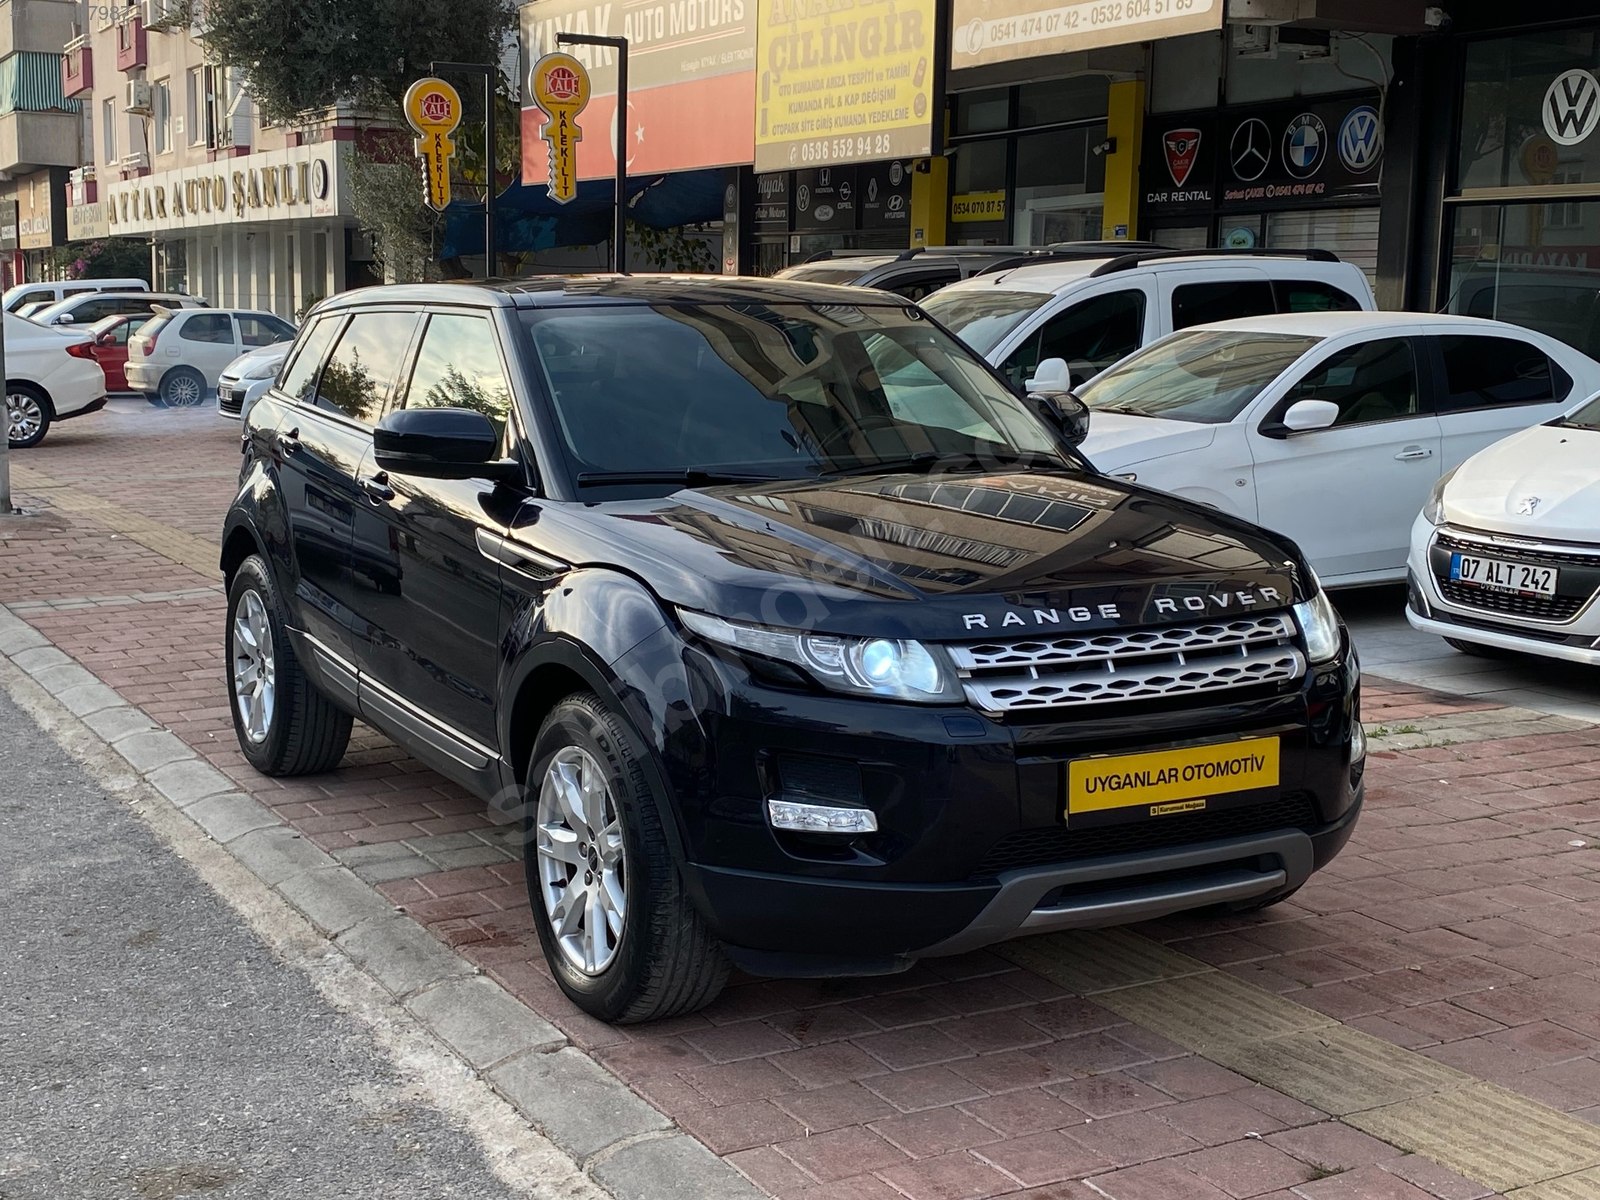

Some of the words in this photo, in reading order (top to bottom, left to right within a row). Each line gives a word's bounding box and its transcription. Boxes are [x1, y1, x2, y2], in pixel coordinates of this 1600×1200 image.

[528, 3, 613, 70] KIYAK
[622, 8, 663, 46] AUTO
[670, 0, 745, 37] MOTORS
[990, 23, 1017, 42] 0541
[1021, 18, 1042, 37] 474
[1046, 14, 1060, 33] 07
[1063, 11, 1079, 29] 42
[1091, 5, 1123, 25] 0532
[1126, 0, 1151, 19] 604
[1155, 0, 1170, 14] 51
[768, 2, 925, 83] ÇİLİNGİR
[545, 76, 579, 95] KALE
[778, 83, 792, 97] OTO
[793, 78, 825, 94] KUMANDA
[826, 74, 846, 89] ARIZA
[848, 68, 875, 86] TESPİTİ
[876, 71, 885, 81] ve
[886, 62, 912, 80] TAMİRİ
[421, 101, 452, 118] KALE
[788, 98, 823, 115] KUMANDA
[824, 93, 836, 110] PİL
[837, 95, 843, 107] &
[844, 91, 860, 106] KAP
[861, 84, 897, 105] DEĞİŞİMİ
[772, 121, 800, 137] OTOPARK
[801, 118, 815, 132] SİTE
[815, 116, 833, 133] GİRİŞ
[834, 112, 867, 128] KUMANDA
[868, 107, 910, 124] YEDEKLEME
[801, 140, 829, 162] 0536
[832, 137, 854, 159] 552
[857, 135, 872, 156] 94
[875, 133, 891, 154] 28
[109, 185, 167, 225] AYTAR
[172, 174, 226, 218] AUTO
[232, 160, 310, 218] ŞANLI
[837, 201, 853, 210] OPEL
[953, 201, 970, 215] 0534
[971, 201, 985, 214] 070
[986, 200, 996, 213] 87
[997, 200, 1006, 212] 57
[1147, 192, 1168, 203] CAR
[1171, 190, 1211, 202] RENTAL
[1461, 558, 1481, 580] 07
[1485, 561, 1516, 586] ALT
[1520, 567, 1550, 592] 242
[963, 604, 1121, 630] RANGE
[1154, 586, 1282, 614] ROVER
[1085, 766, 1179, 794] UYGANLAR
[1181, 754, 1266, 781] OTOMOTİV
